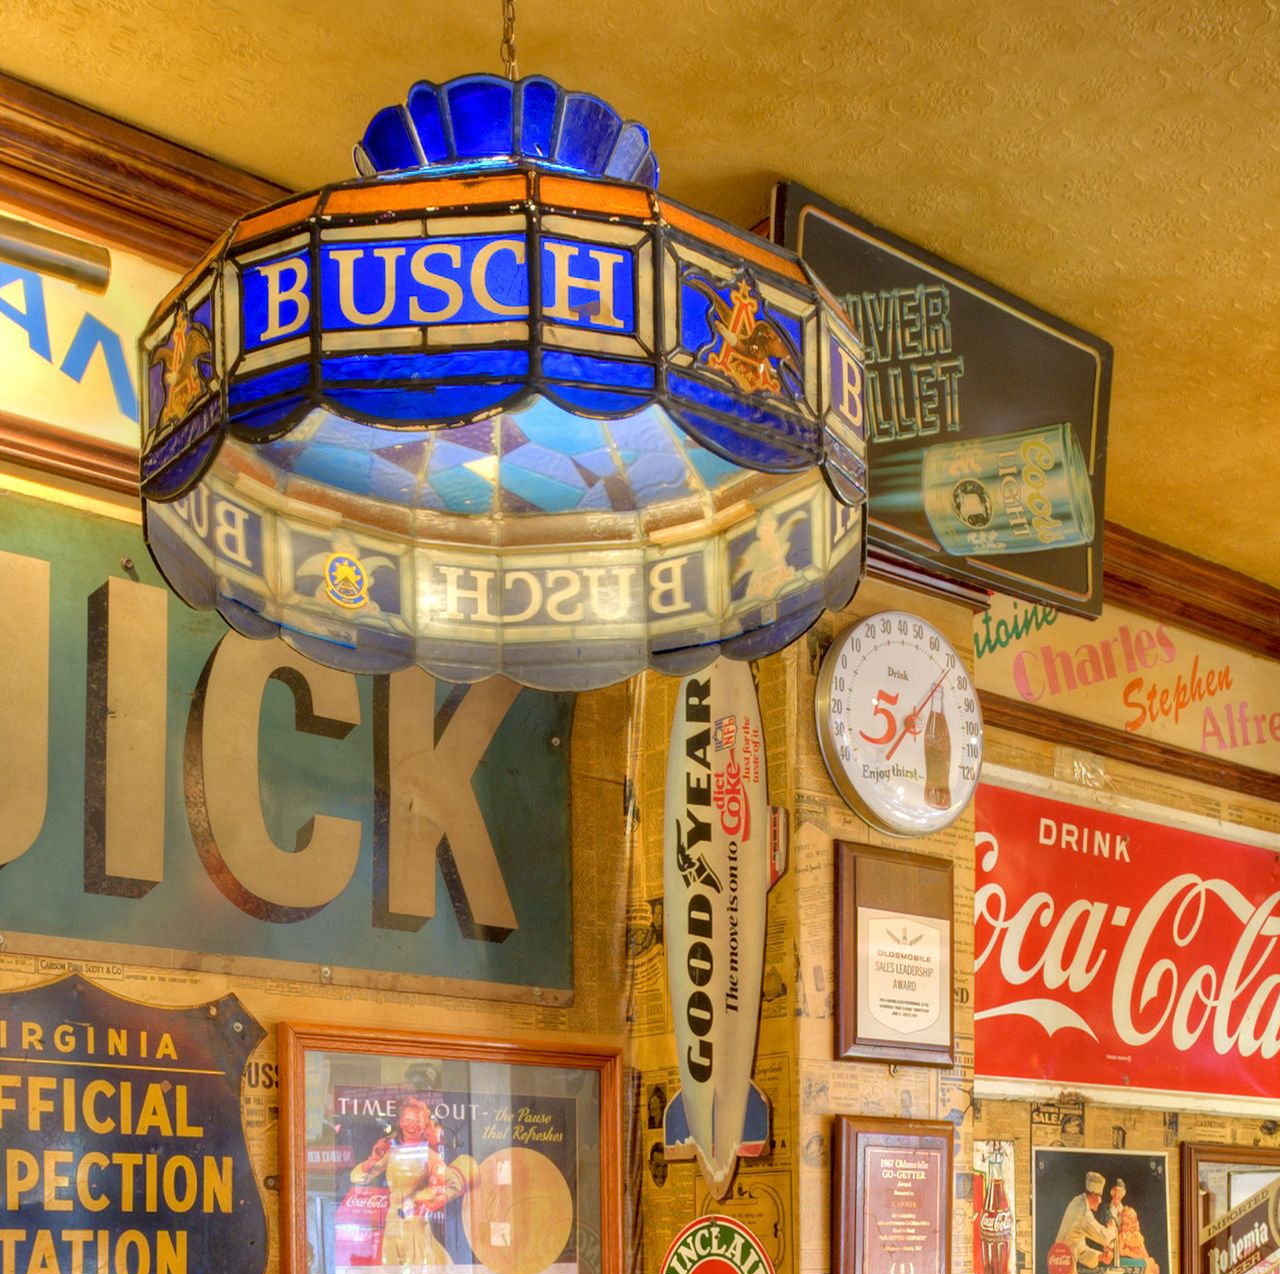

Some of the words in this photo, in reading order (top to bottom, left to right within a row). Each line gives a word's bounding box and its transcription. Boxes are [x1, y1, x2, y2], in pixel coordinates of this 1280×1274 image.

[257, 239, 626, 343] BUSCH
[837, 284, 953, 364] LVER
[863, 356, 965, 443] LLET
[996, 450, 1033, 539] LIGHT
[865, 623, 876, 639] 20
[880, 619, 892, 634] 30
[897, 620, 909, 635] 40
[913, 625, 924, 640] 50
[851, 638, 862, 652] 10
[929, 637, 940, 651] 60
[841, 655, 848, 669] 0
[945, 653, 956, 668] 70
[1012, 622, 1177, 702] Charles
[887, 666, 910, 681] Drink
[957, 676, 968, 692] 80
[1122, 654, 1233, 733] Stephen
[964, 699, 975, 713] 90
[741, 715, 751, 735] the
[965, 721, 979, 736] 100
[967, 743, 979, 758] 110
[742, 755, 751, 783] Just
[862, 763, 891, 784] Enjoy
[713, 770, 725, 810] diet
[719, 760, 742, 836] Coke
[1038, 817, 1131, 863] DRINK
[726, 841, 738, 862] to
[727, 865, 738, 891] on
[726, 892, 738, 913] is
[727, 916, 739, 973] move
[877, 949, 932, 963] OLDSMOBILE
[875, 960, 895, 974] SALES
[895, 961, 934, 978] LEADERSHIP
[725, 975, 739, 1014] The
[893, 978, 917, 992] AWARD
[338, 1097, 398, 1119] TIME
[495, 1107, 516, 1123] the
[518, 1107, 552, 1124] Pause
[482, 1124, 507, 1141] that
[512, 1125, 564, 1143] Refreshes
[882, 1169, 927, 1180] GO-GETTER
[1207, 1189, 1270, 1237] IMPORTED
